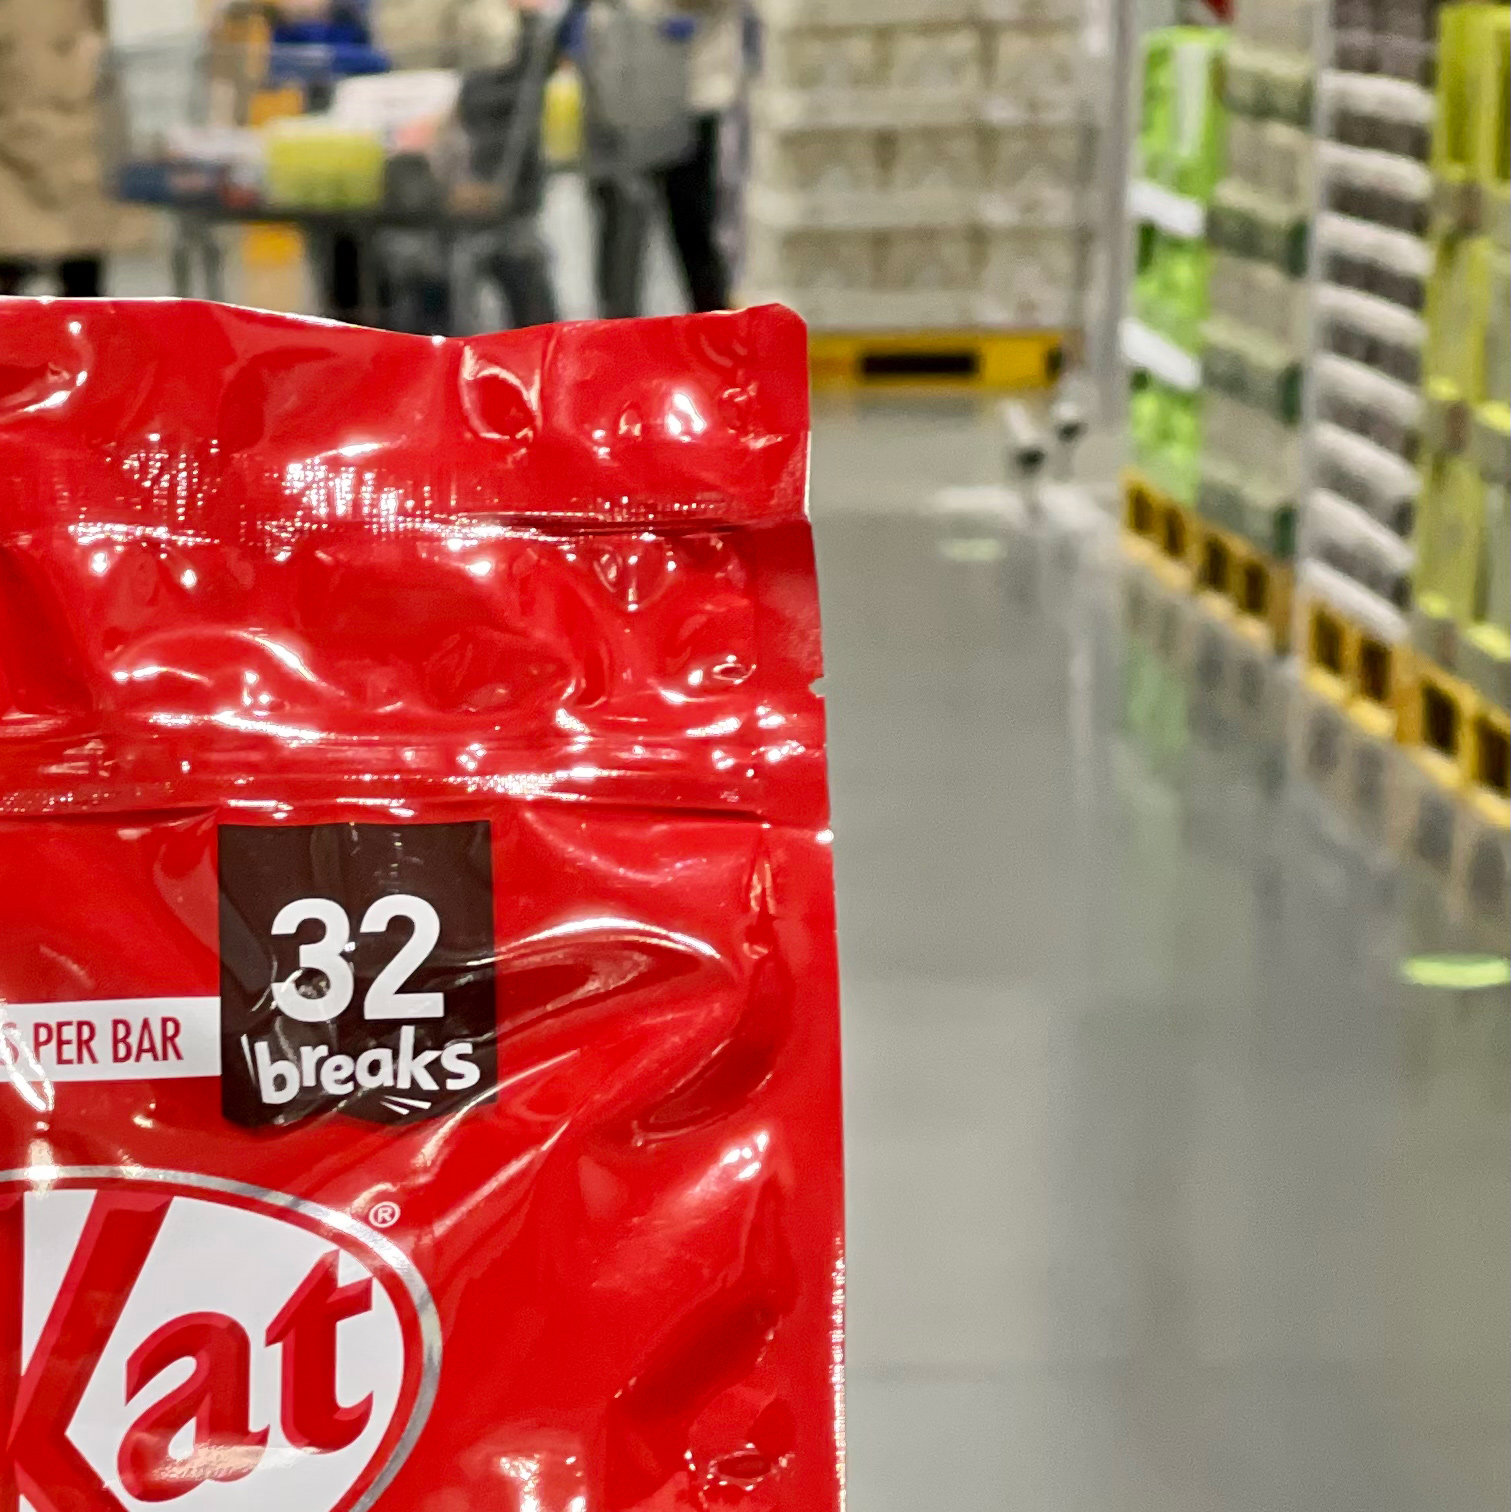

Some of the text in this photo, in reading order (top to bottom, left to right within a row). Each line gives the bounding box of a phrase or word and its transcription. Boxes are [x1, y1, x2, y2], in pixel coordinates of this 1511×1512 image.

[270, 893, 446, 1023] 32
[33, 1019, 99, 1066] PER
[112, 1016, 184, 1063] BAR
[254, 1025, 481, 1104] breaks
